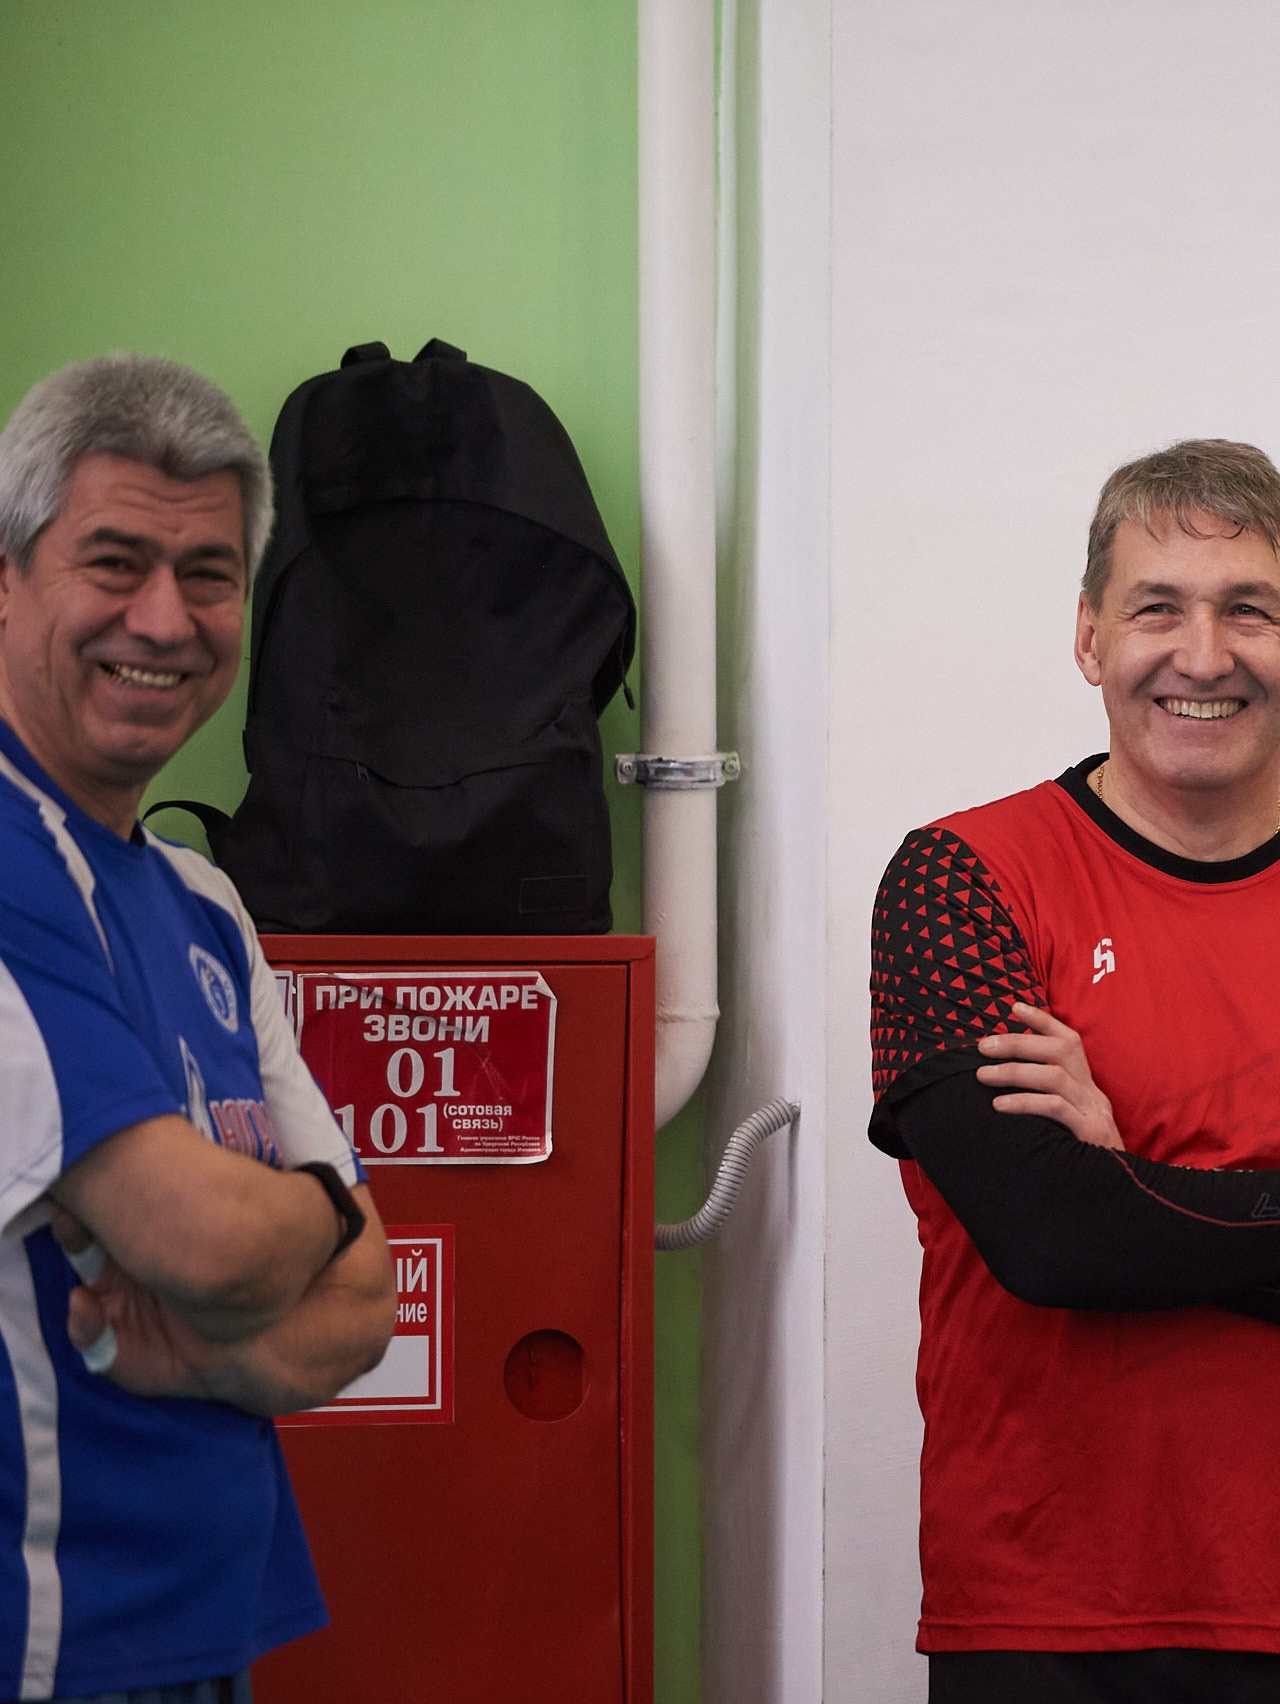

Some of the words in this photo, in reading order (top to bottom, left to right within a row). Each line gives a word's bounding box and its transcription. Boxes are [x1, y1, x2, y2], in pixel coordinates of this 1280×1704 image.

[315, 985, 383, 1010] ПРИ
[395, 984, 539, 1011] ПОЖАРЕ
[363, 1014, 490, 1043] ЗВОНИ
[386, 1047, 461, 1098] 01
[334, 1103, 444, 1154] 101
